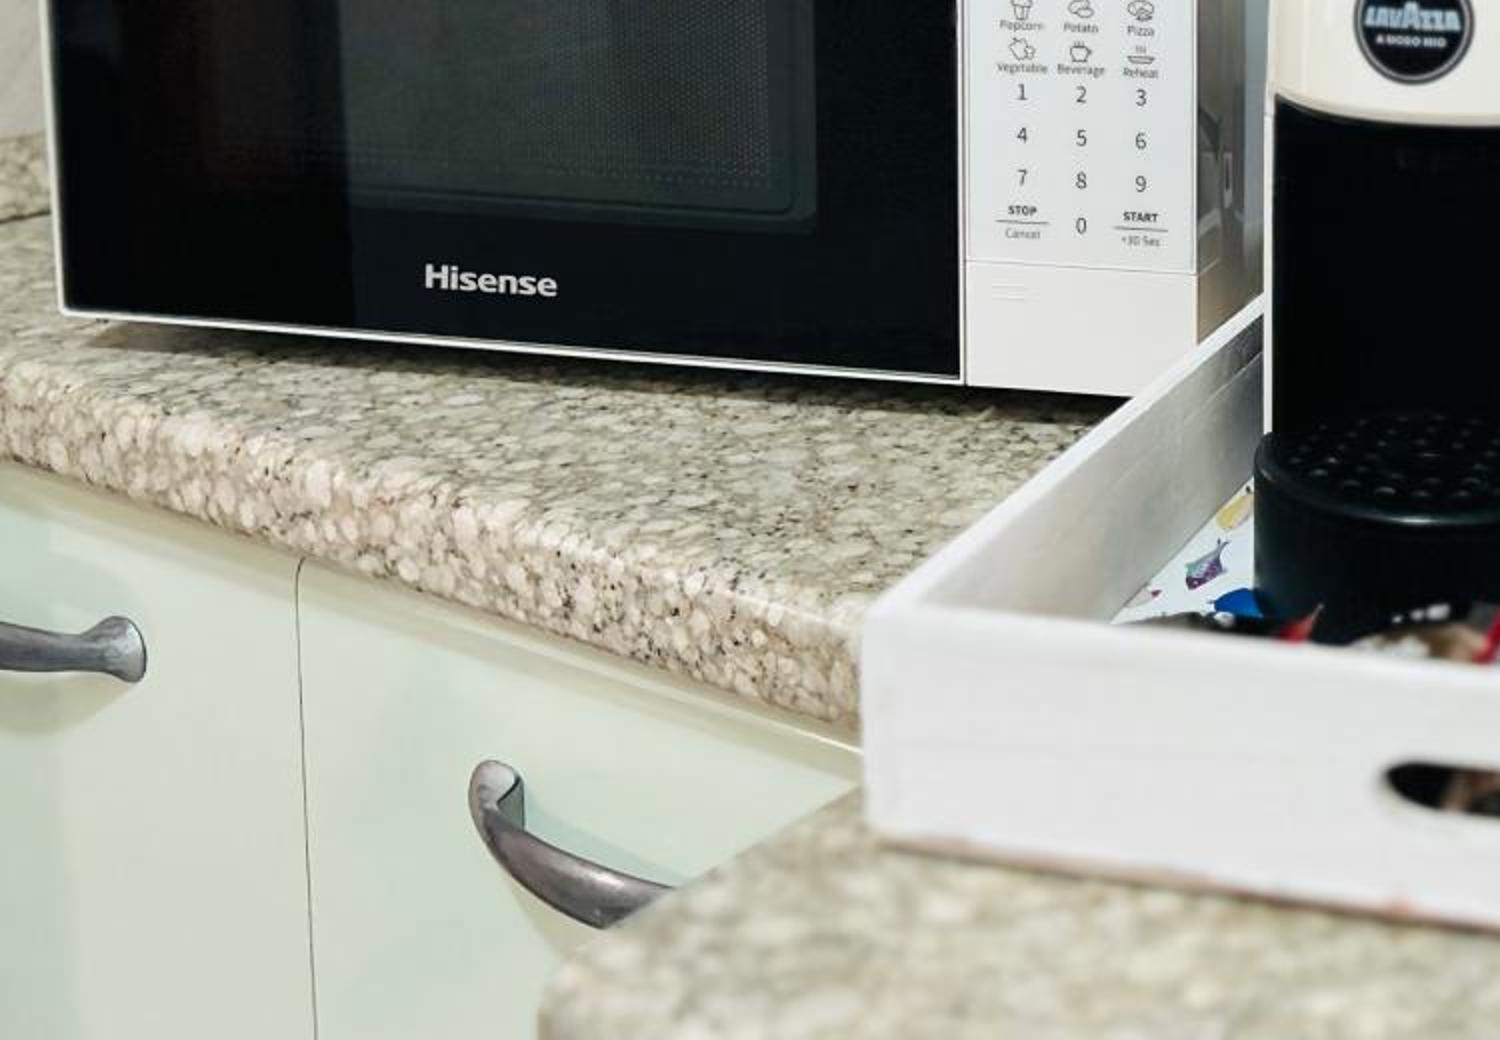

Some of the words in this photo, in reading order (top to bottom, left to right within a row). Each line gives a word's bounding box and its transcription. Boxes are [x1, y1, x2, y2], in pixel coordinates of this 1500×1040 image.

[1365, 0, 1461, 32] LAVAZZA
[1127, 25, 1155, 37] Pizza
[1057, 64, 1105, 79] Beverage
[1018, 83, 1028, 101] 1
[1076, 86, 1087, 103] 2
[1136, 89, 1147, 107] 3
[1017, 127, 1028, 144] 4
[1076, 129, 1087, 147] 5
[1135, 133, 1147, 150] 6
[1018, 169, 1028, 186] 7
[1076, 172, 1087, 189] 8
[1136, 176, 1147, 193] 9
[1008, 205, 1038, 216] STOP
[1123, 211, 1159, 223] START
[1076, 217, 1087, 234] 0
[425, 263, 557, 297] Hisense
